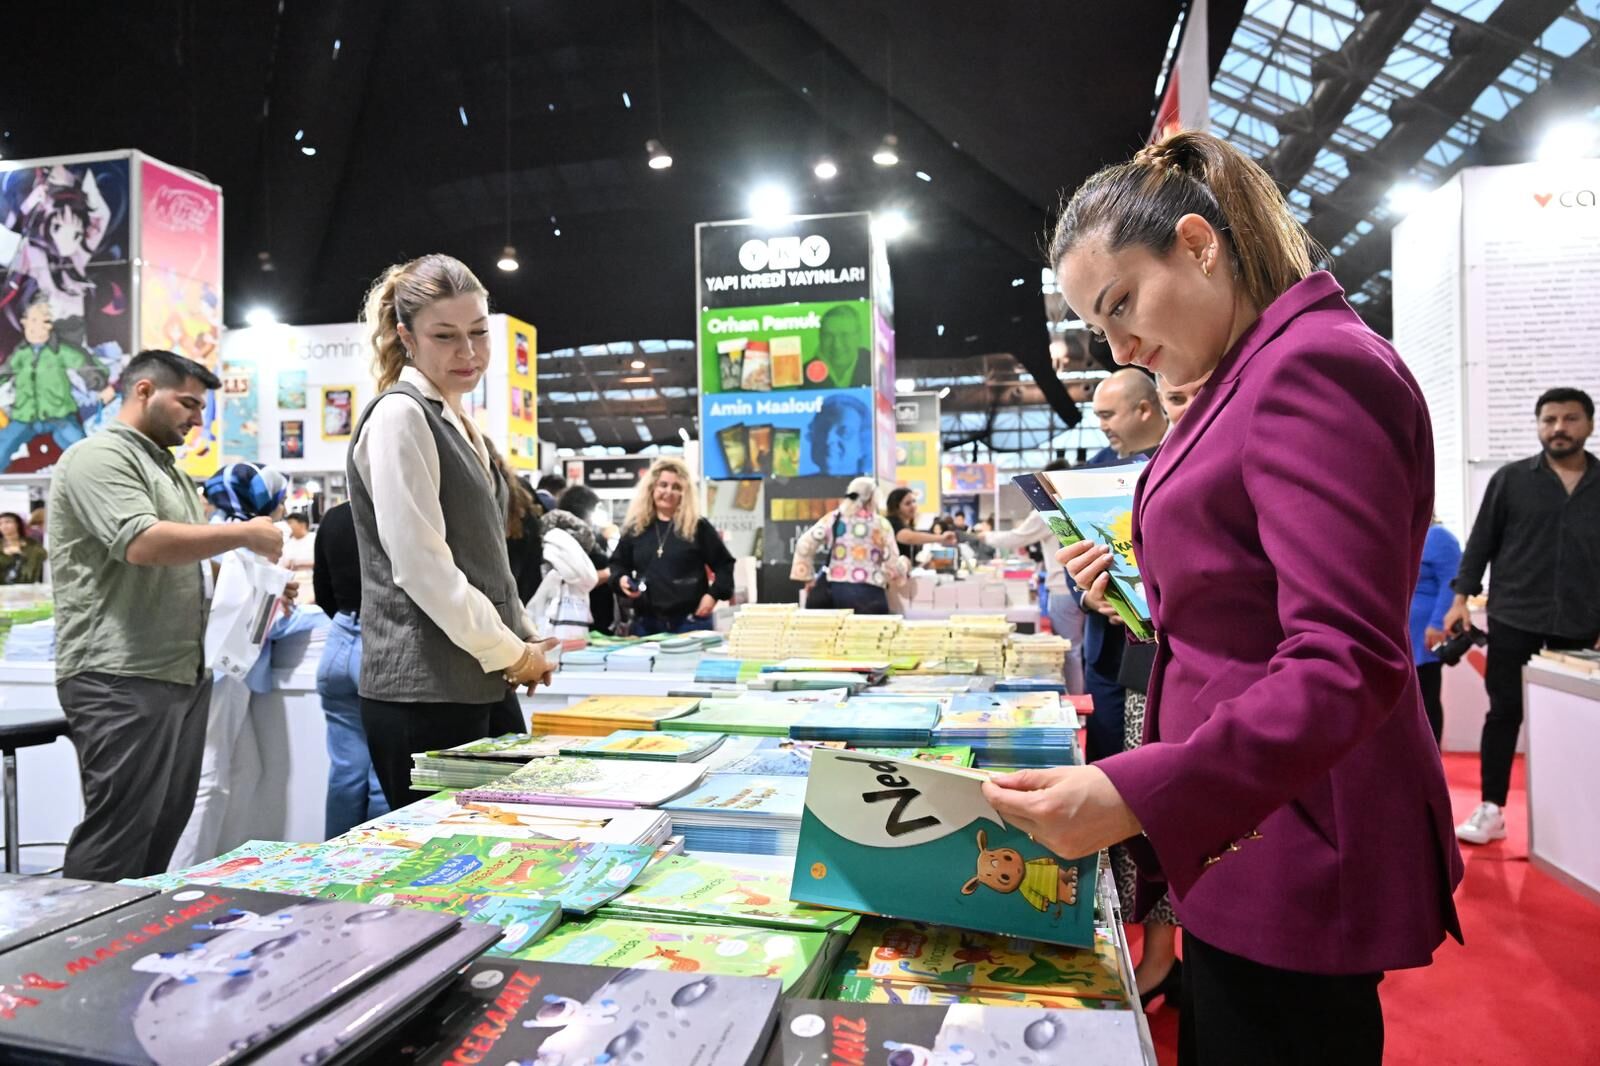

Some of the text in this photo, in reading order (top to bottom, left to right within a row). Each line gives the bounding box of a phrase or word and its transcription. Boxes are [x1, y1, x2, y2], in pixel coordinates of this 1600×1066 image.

[705, 266, 865, 291] YAPI KREDİ YAYINLARI
[707, 311, 821, 334] Orhan Pamuk
[710, 395, 825, 416] Amin Maalouf
